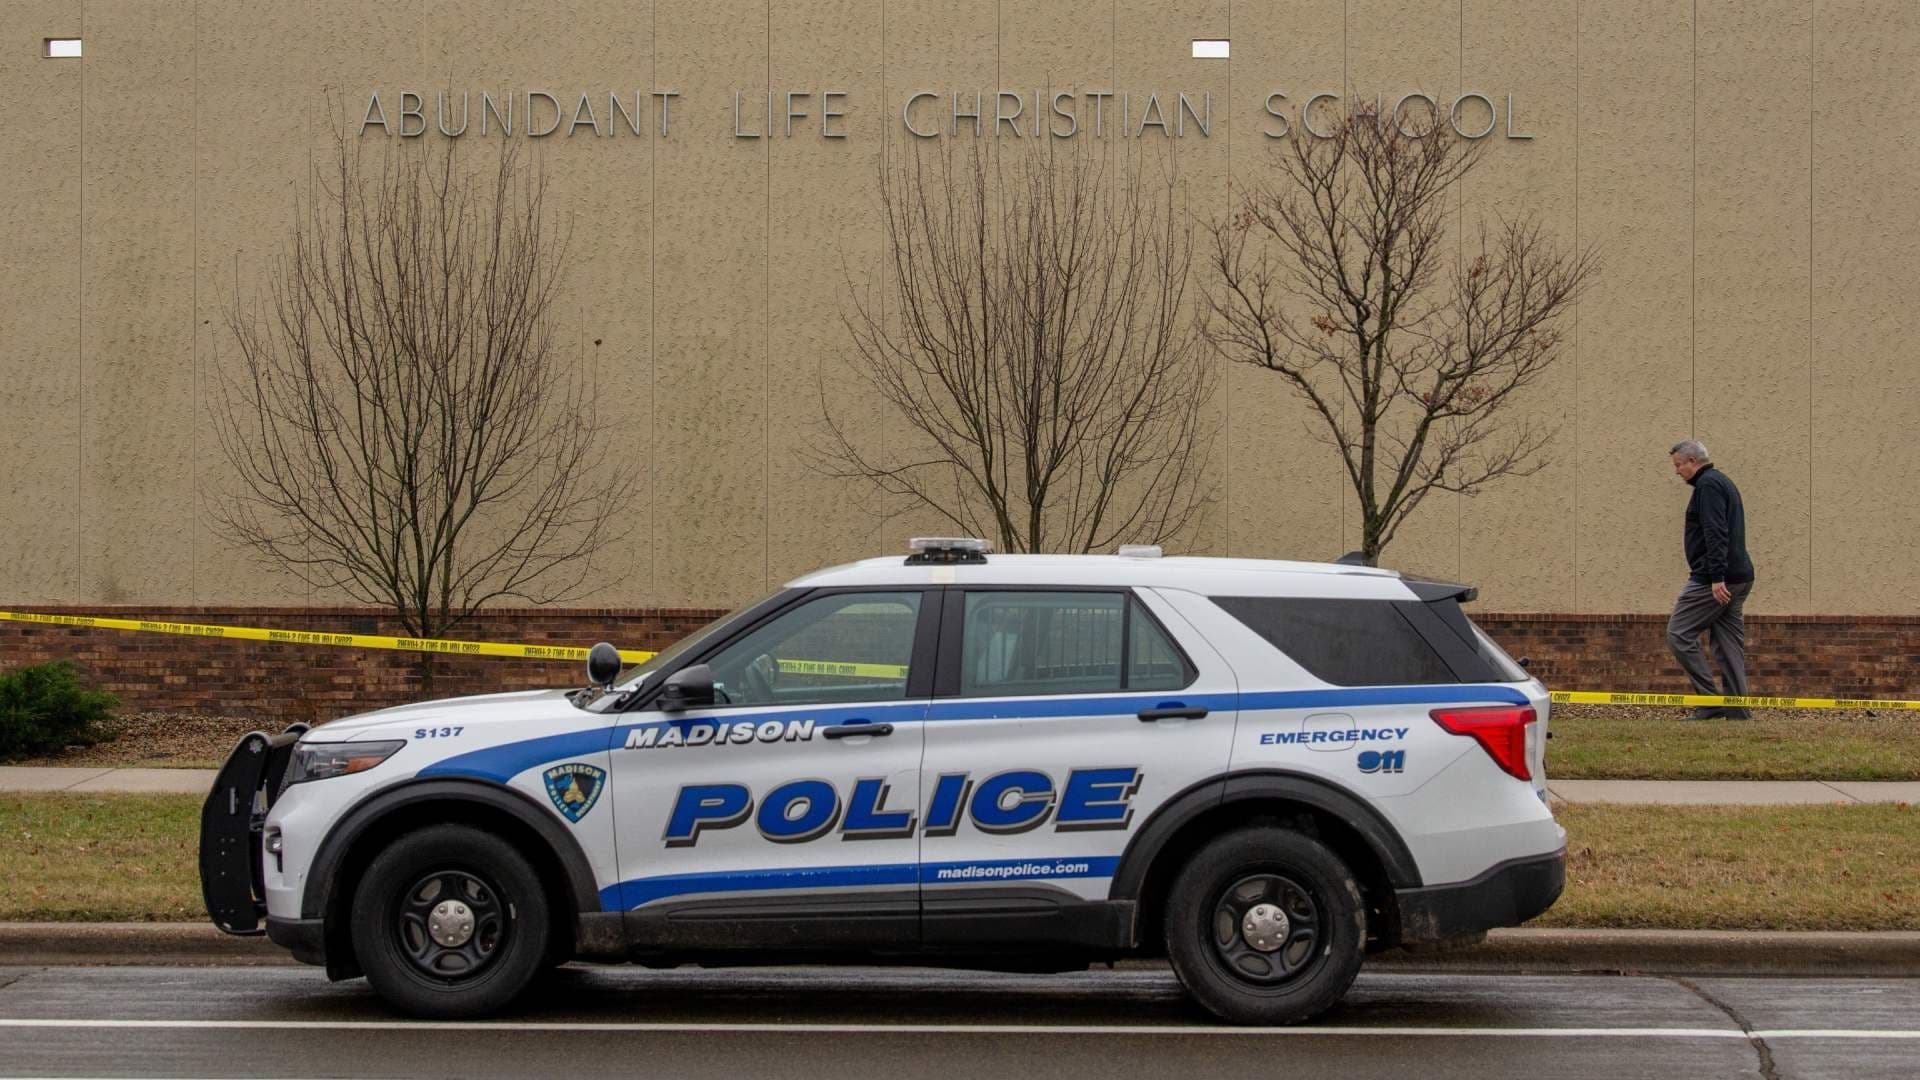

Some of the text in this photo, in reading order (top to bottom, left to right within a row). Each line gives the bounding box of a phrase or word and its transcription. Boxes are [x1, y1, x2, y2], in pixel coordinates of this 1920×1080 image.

[358, 90, 1533, 139] ABUNDANT LIFE CHRISTIAN SCHOOL
[414, 726, 465, 740] S137
[624, 720, 816, 749] MADISON
[1259, 727, 1410, 745] EMERGENCY
[1357, 750, 1406, 773] 911
[548, 764, 602, 780] MADISON
[661, 765, 1143, 849] POLICE
[937, 862, 1089, 880] madisonpolice.com
